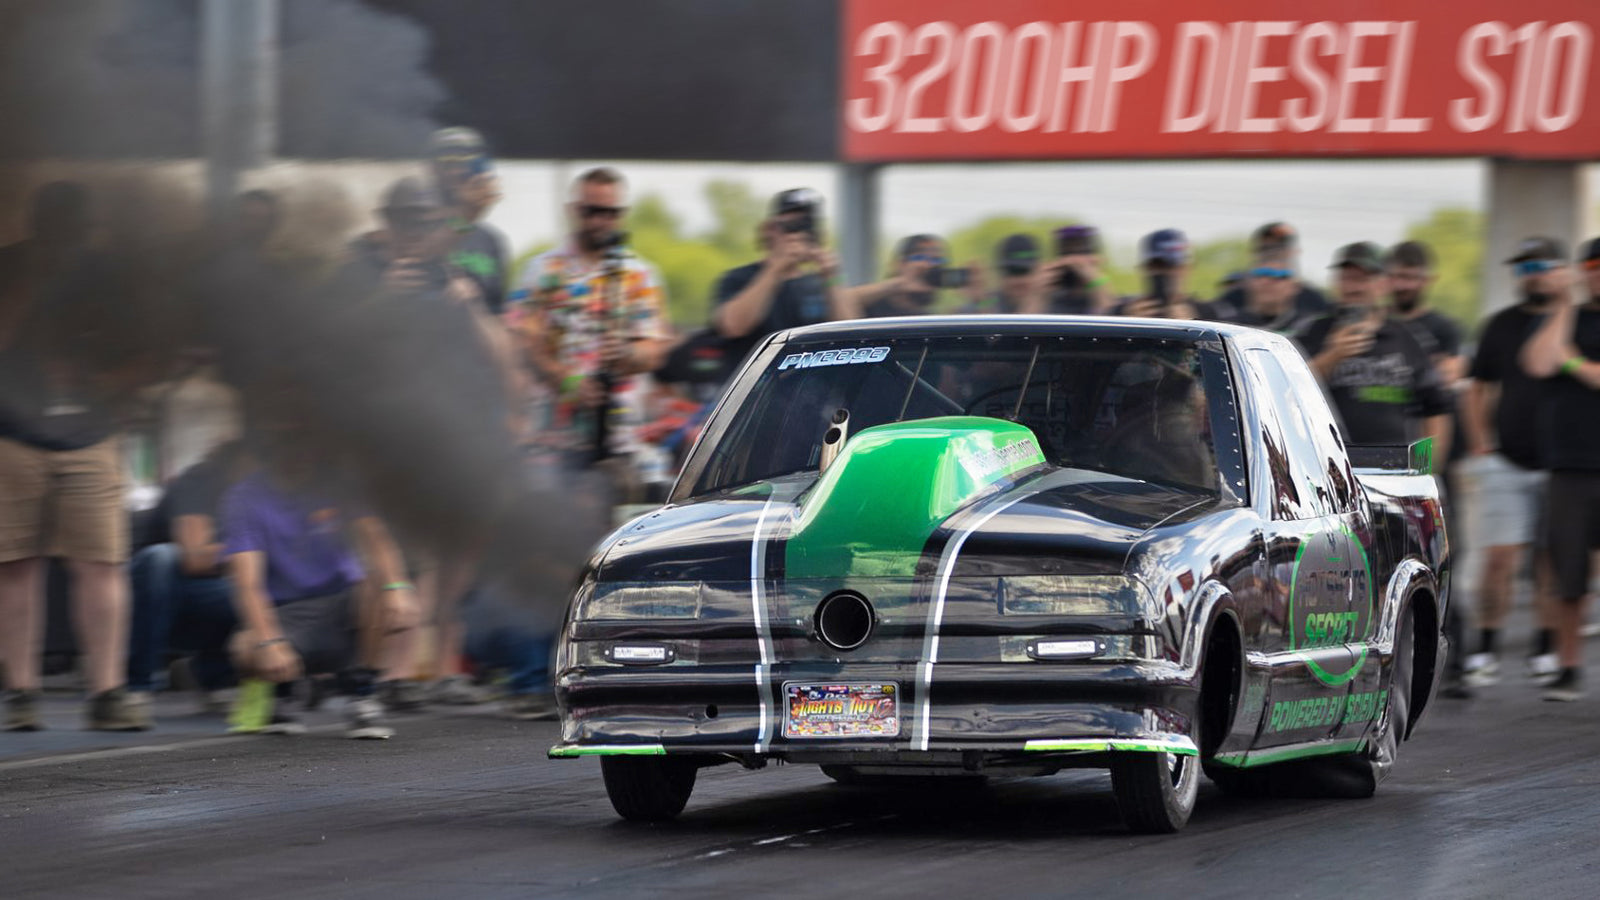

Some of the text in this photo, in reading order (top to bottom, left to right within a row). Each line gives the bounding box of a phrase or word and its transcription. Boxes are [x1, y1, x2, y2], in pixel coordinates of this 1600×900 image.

[845, 20, 1594, 134] 3200HP DIESEL S10
[778, 346, 891, 370] PM3393
[1305, 612, 1359, 643] SECRET
[1270, 698, 1328, 732] POWERED
[1324, 695, 1347, 726] BY
